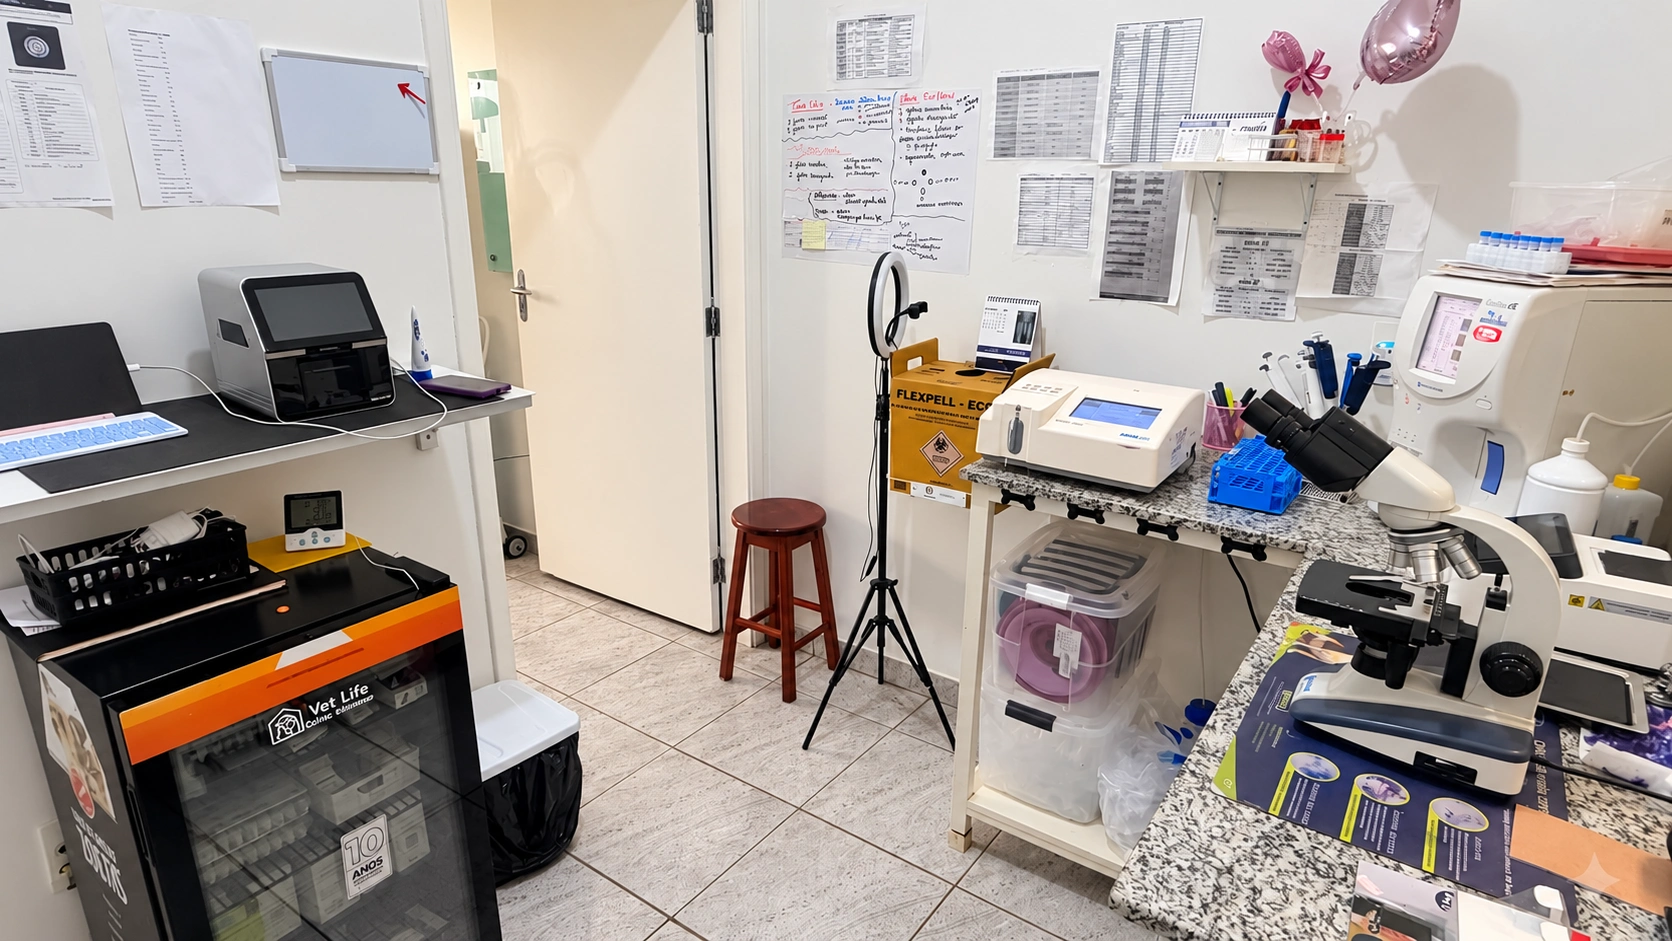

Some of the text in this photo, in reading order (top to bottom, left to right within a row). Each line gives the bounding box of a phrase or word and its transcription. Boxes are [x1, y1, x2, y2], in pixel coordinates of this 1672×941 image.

[896, 389, 956, 407] FLEXPELL
[309, 697, 336, 716] Vet
[340, 684, 369, 704] Life
[344, 826, 385, 866] 10
[352, 855, 383, 880] ANOS
